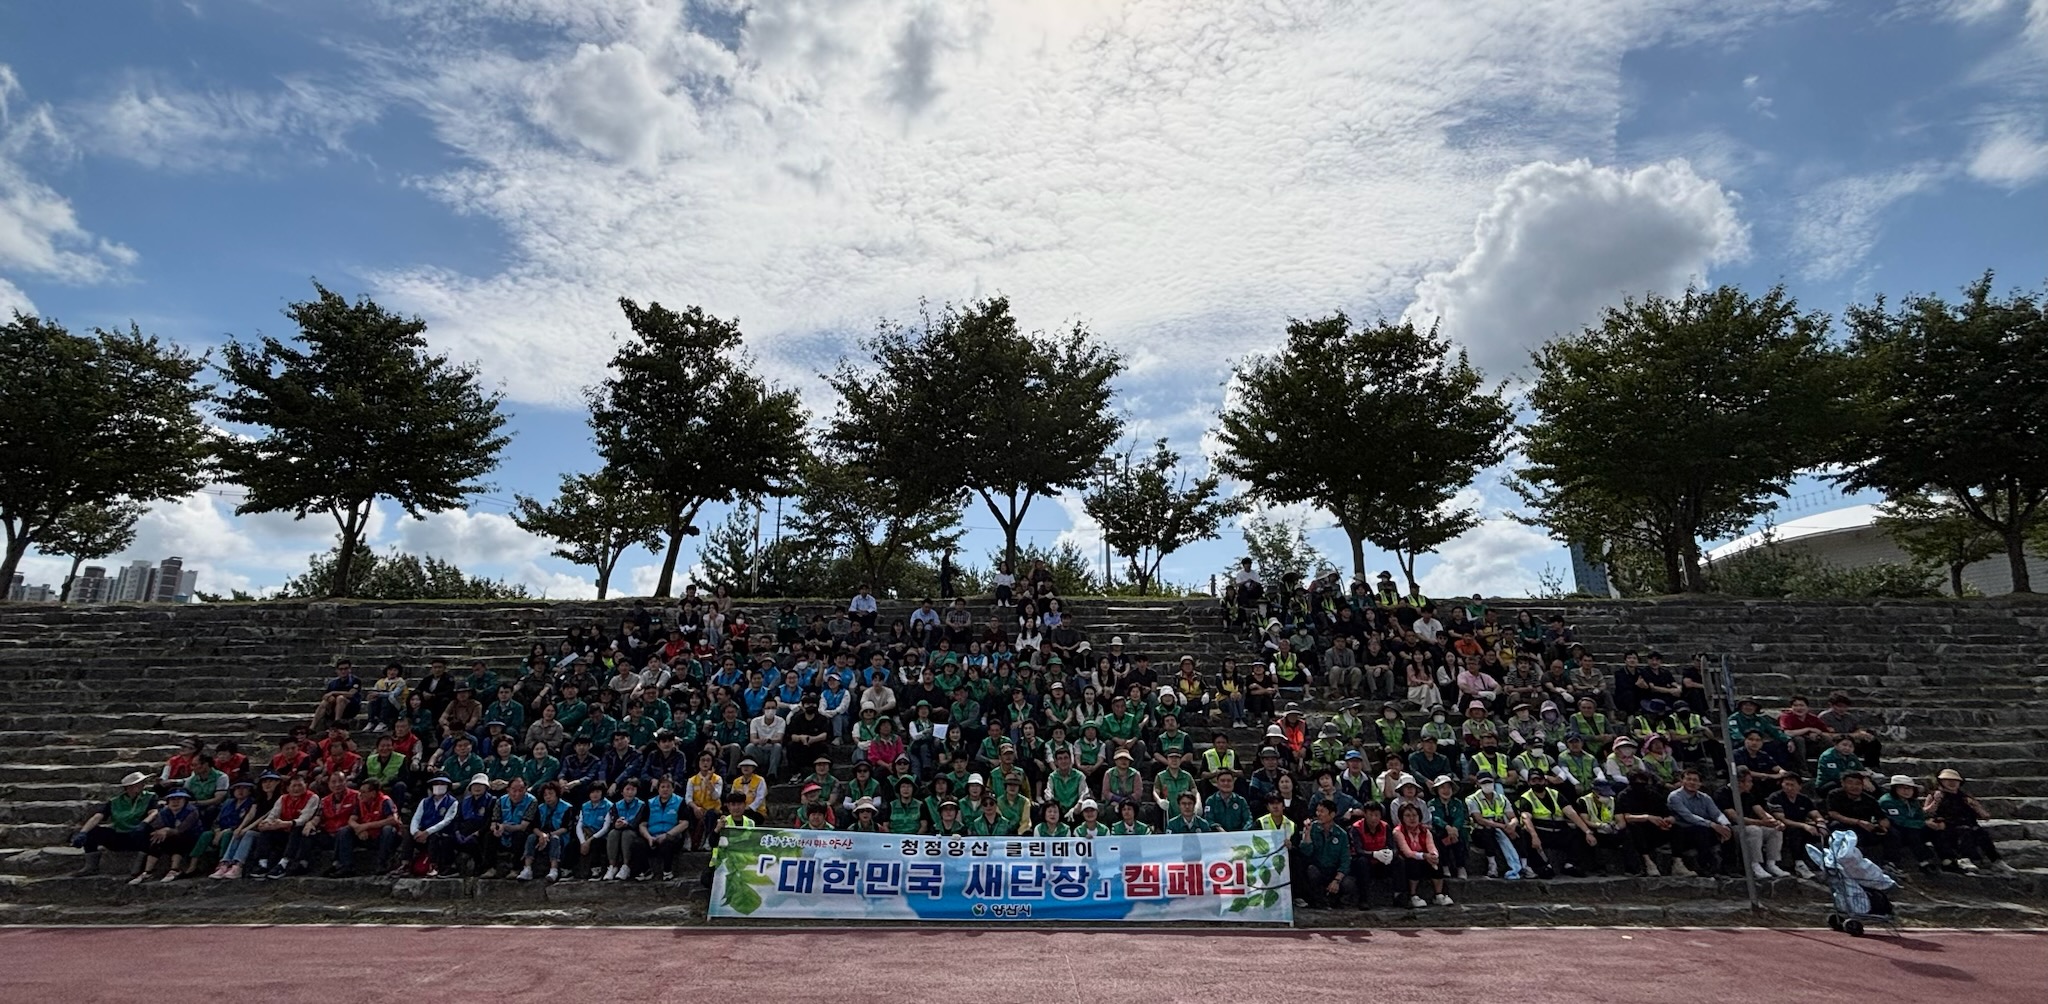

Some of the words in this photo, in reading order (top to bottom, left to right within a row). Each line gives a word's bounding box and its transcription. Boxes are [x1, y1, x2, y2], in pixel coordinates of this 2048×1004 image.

[829, 837, 853, 850] 양산
[901, 839, 989, 857] 청정양산
[1005, 841, 1092, 857] 클린데이
[758, 857, 943, 897] 「대한민국
[964, 863, 1110, 899] 새단장」
[1124, 862, 1247, 897] 캠페인
[991, 904, 1031, 917] 양산시
